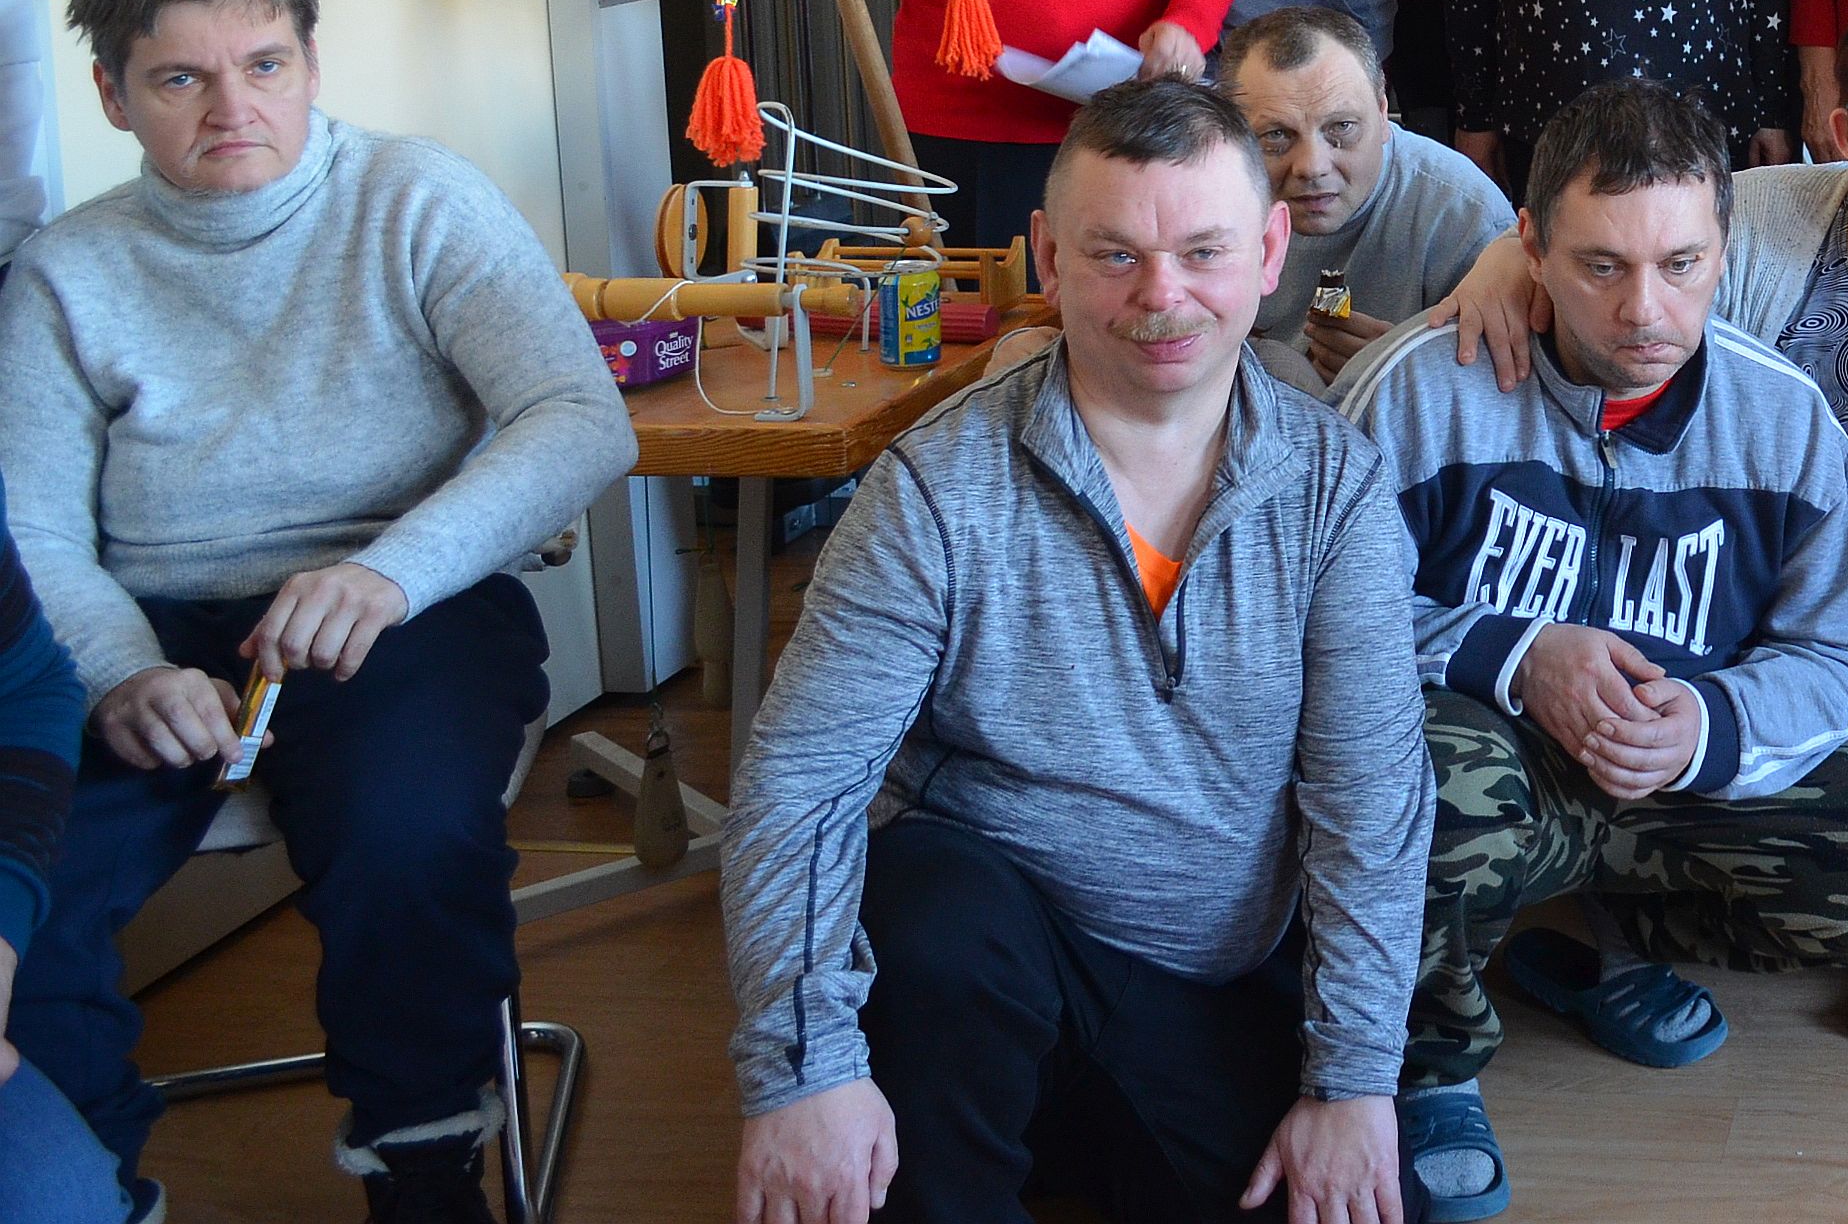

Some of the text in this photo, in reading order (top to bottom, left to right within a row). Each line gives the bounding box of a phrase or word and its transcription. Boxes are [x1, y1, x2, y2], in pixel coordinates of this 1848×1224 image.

[655, 335, 693, 357] Quality
[659, 352, 690, 371] Street
[1463, 487, 1725, 656] EVER LAST
